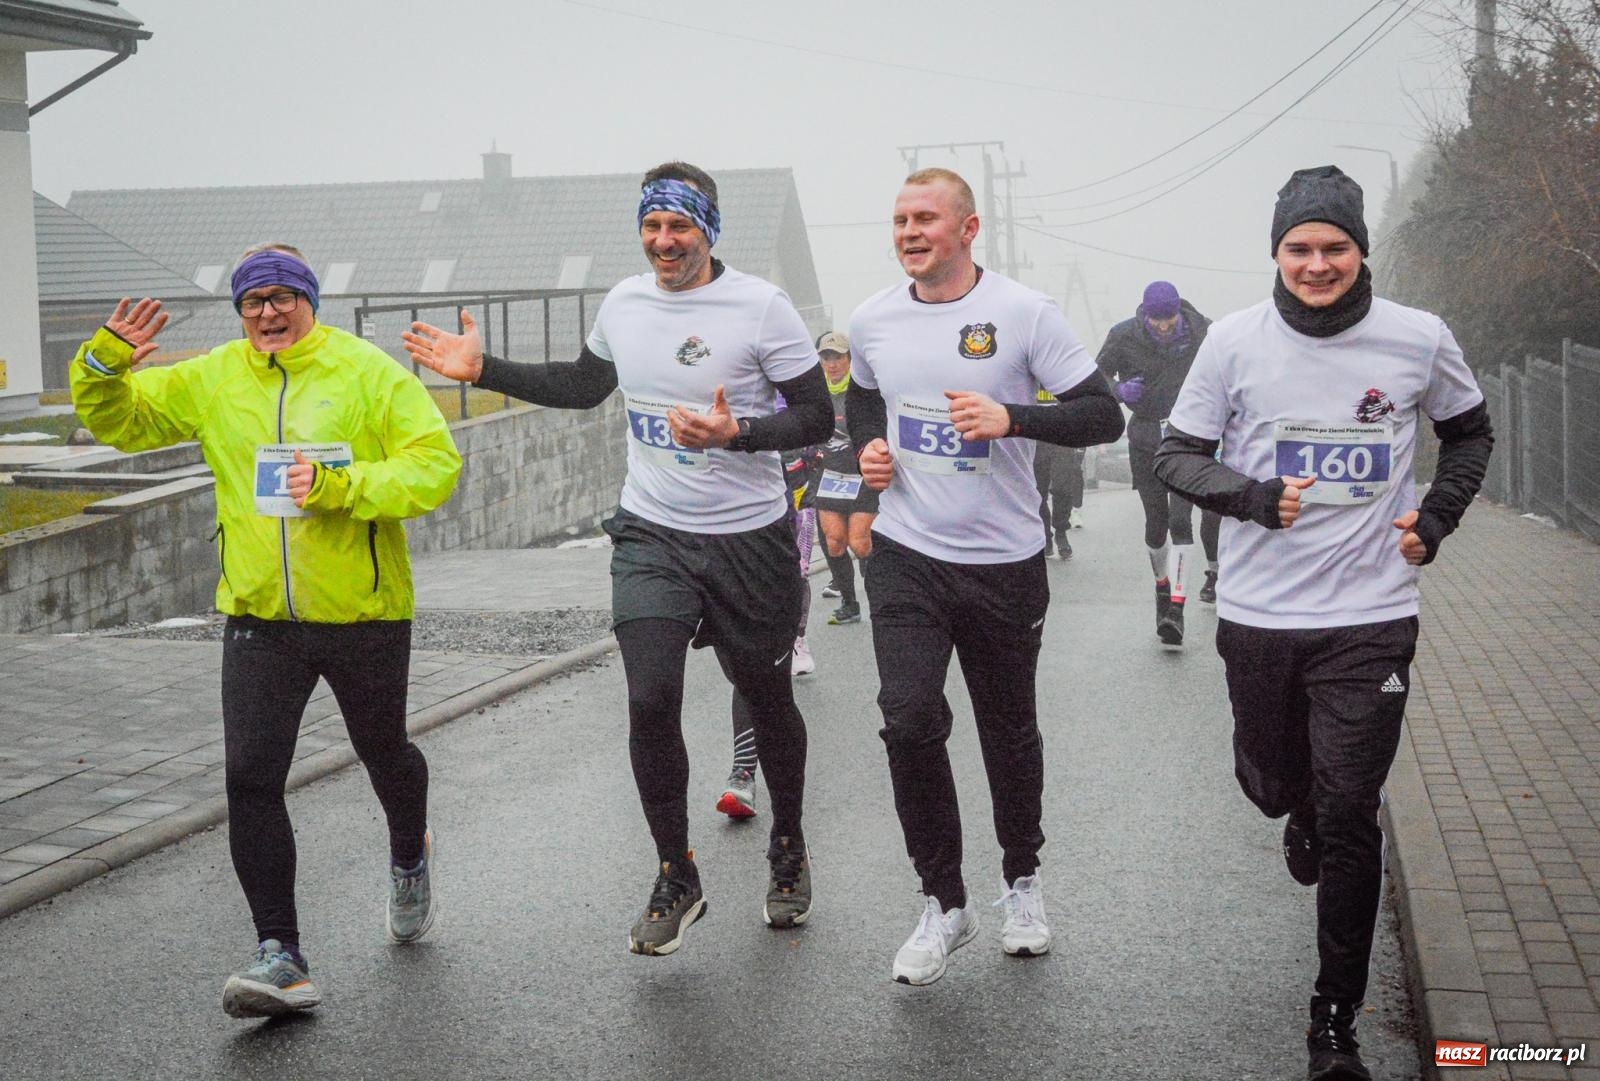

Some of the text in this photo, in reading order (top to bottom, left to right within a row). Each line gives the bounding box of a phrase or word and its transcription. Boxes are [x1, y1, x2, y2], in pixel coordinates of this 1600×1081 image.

[638, 416, 688, 449] 13
[920, 423, 962, 455] 53
[1297, 445, 1373, 480] 160
[831, 480, 850, 493] 72
